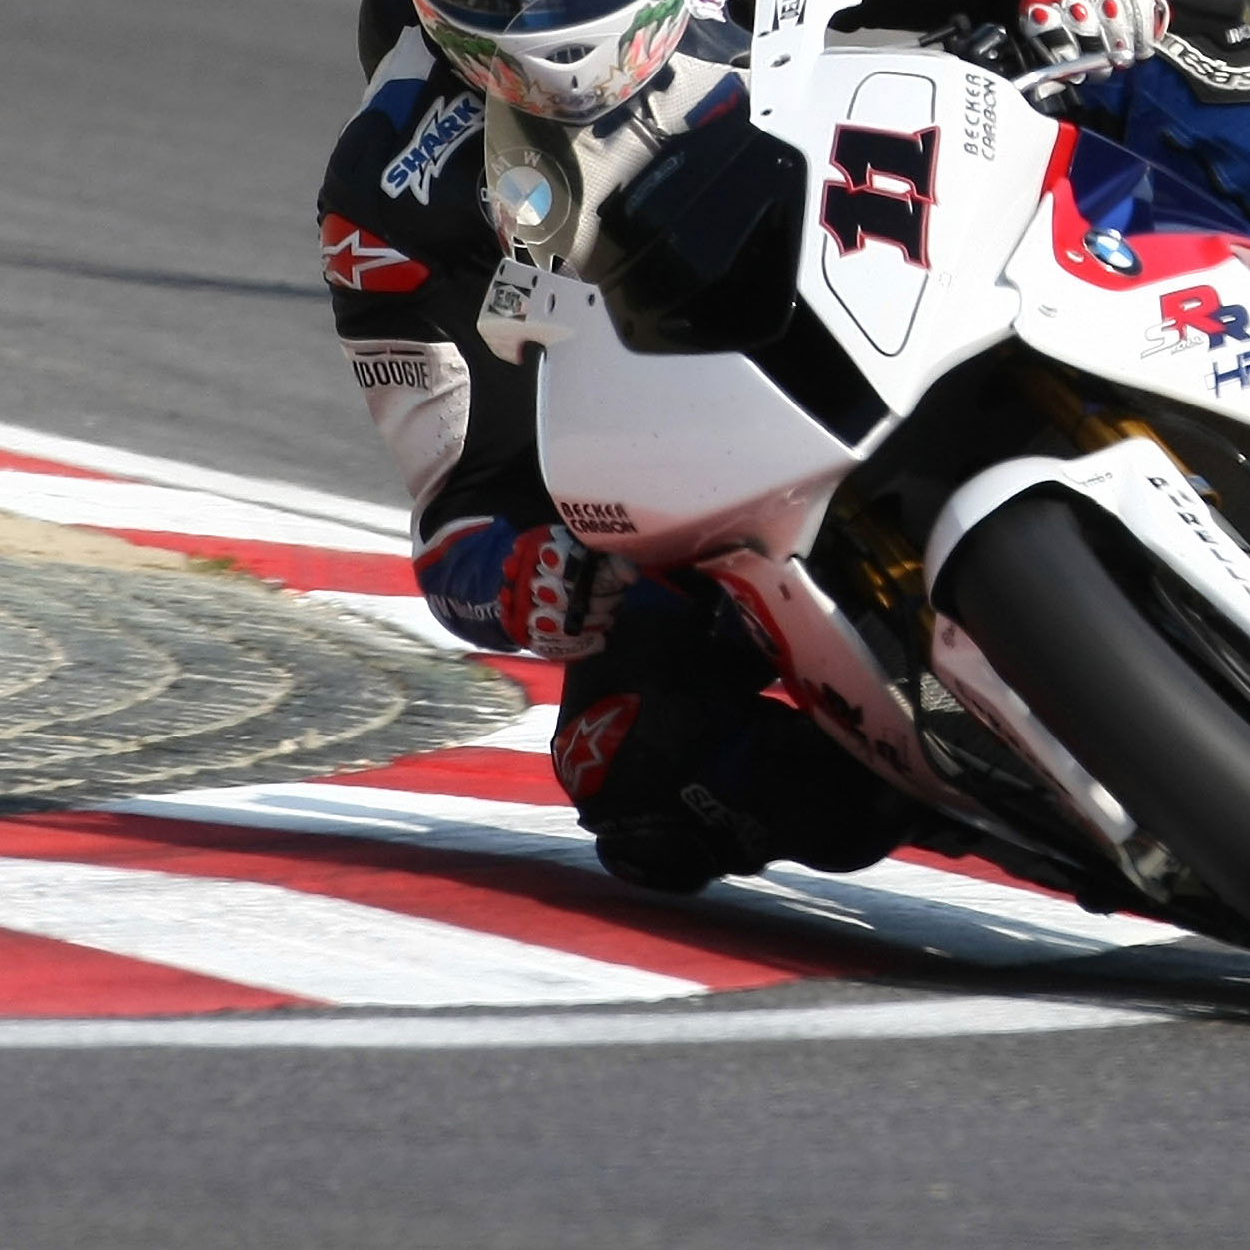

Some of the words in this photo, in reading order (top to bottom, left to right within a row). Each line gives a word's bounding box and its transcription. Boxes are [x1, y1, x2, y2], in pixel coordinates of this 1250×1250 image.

[386, 98, 481, 189] SHARK
[964, 73, 981, 156] BECKER
[982, 77, 997, 162] CARBON
[820, 124, 942, 271] 11
